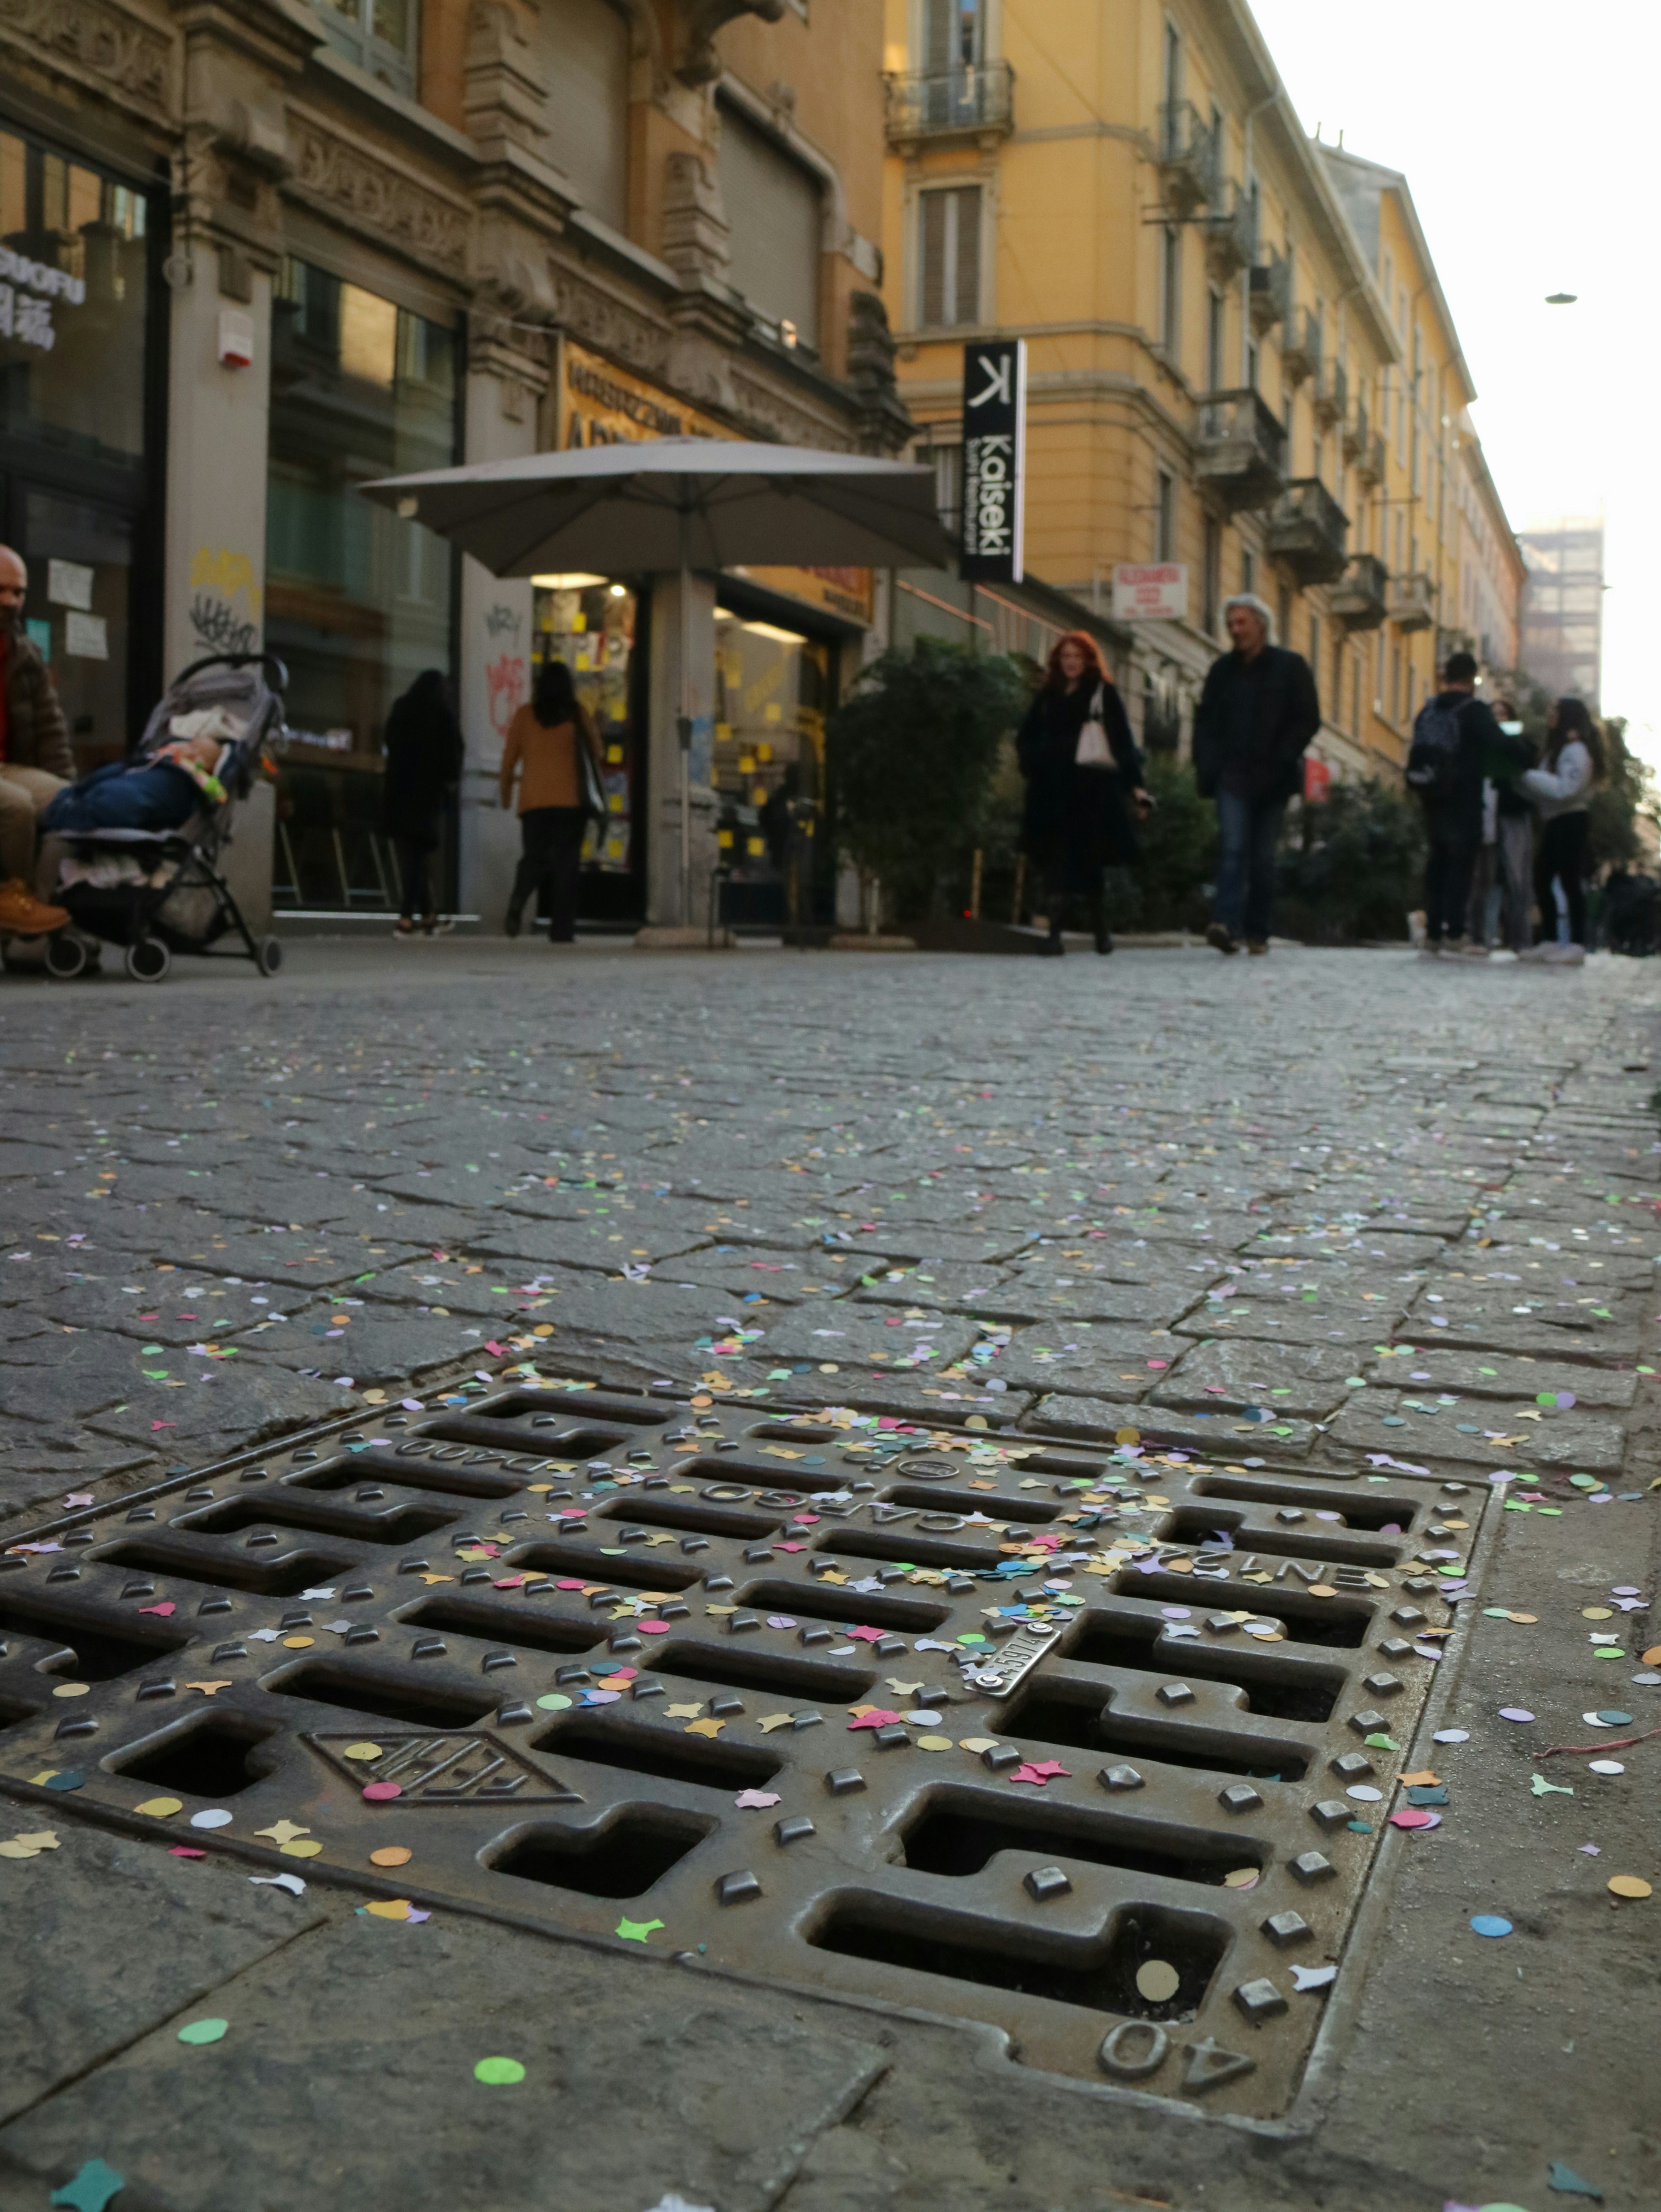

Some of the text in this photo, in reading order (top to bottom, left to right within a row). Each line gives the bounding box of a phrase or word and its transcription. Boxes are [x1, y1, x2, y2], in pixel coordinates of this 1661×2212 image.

[979, 435, 1012, 555] Kaiseki
[394, 1441, 554, 1474] D400
[699, 1485, 966, 1533] CARGO
[1098, 2020, 1257, 2095] 40
